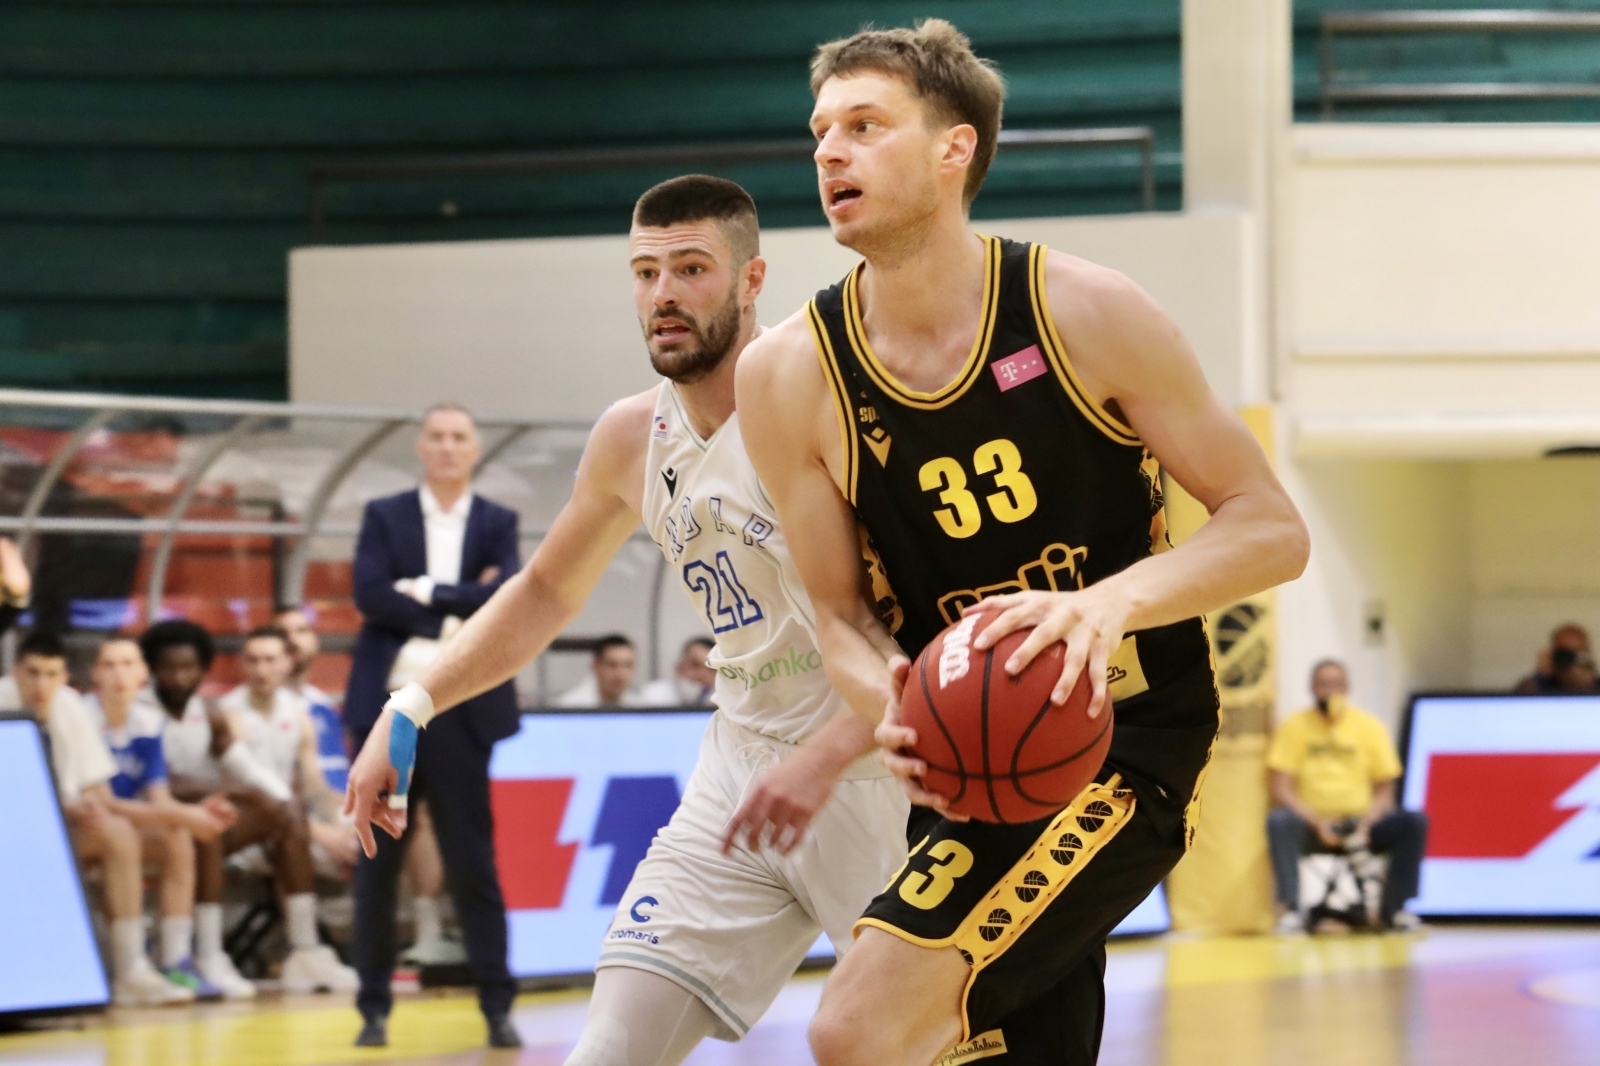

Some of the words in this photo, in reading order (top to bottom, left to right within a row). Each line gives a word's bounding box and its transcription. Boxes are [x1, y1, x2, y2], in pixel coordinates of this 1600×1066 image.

[918, 438, 1038, 538] 33
[683, 550, 764, 634] 21
[610, 929, 659, 945] cromaris
